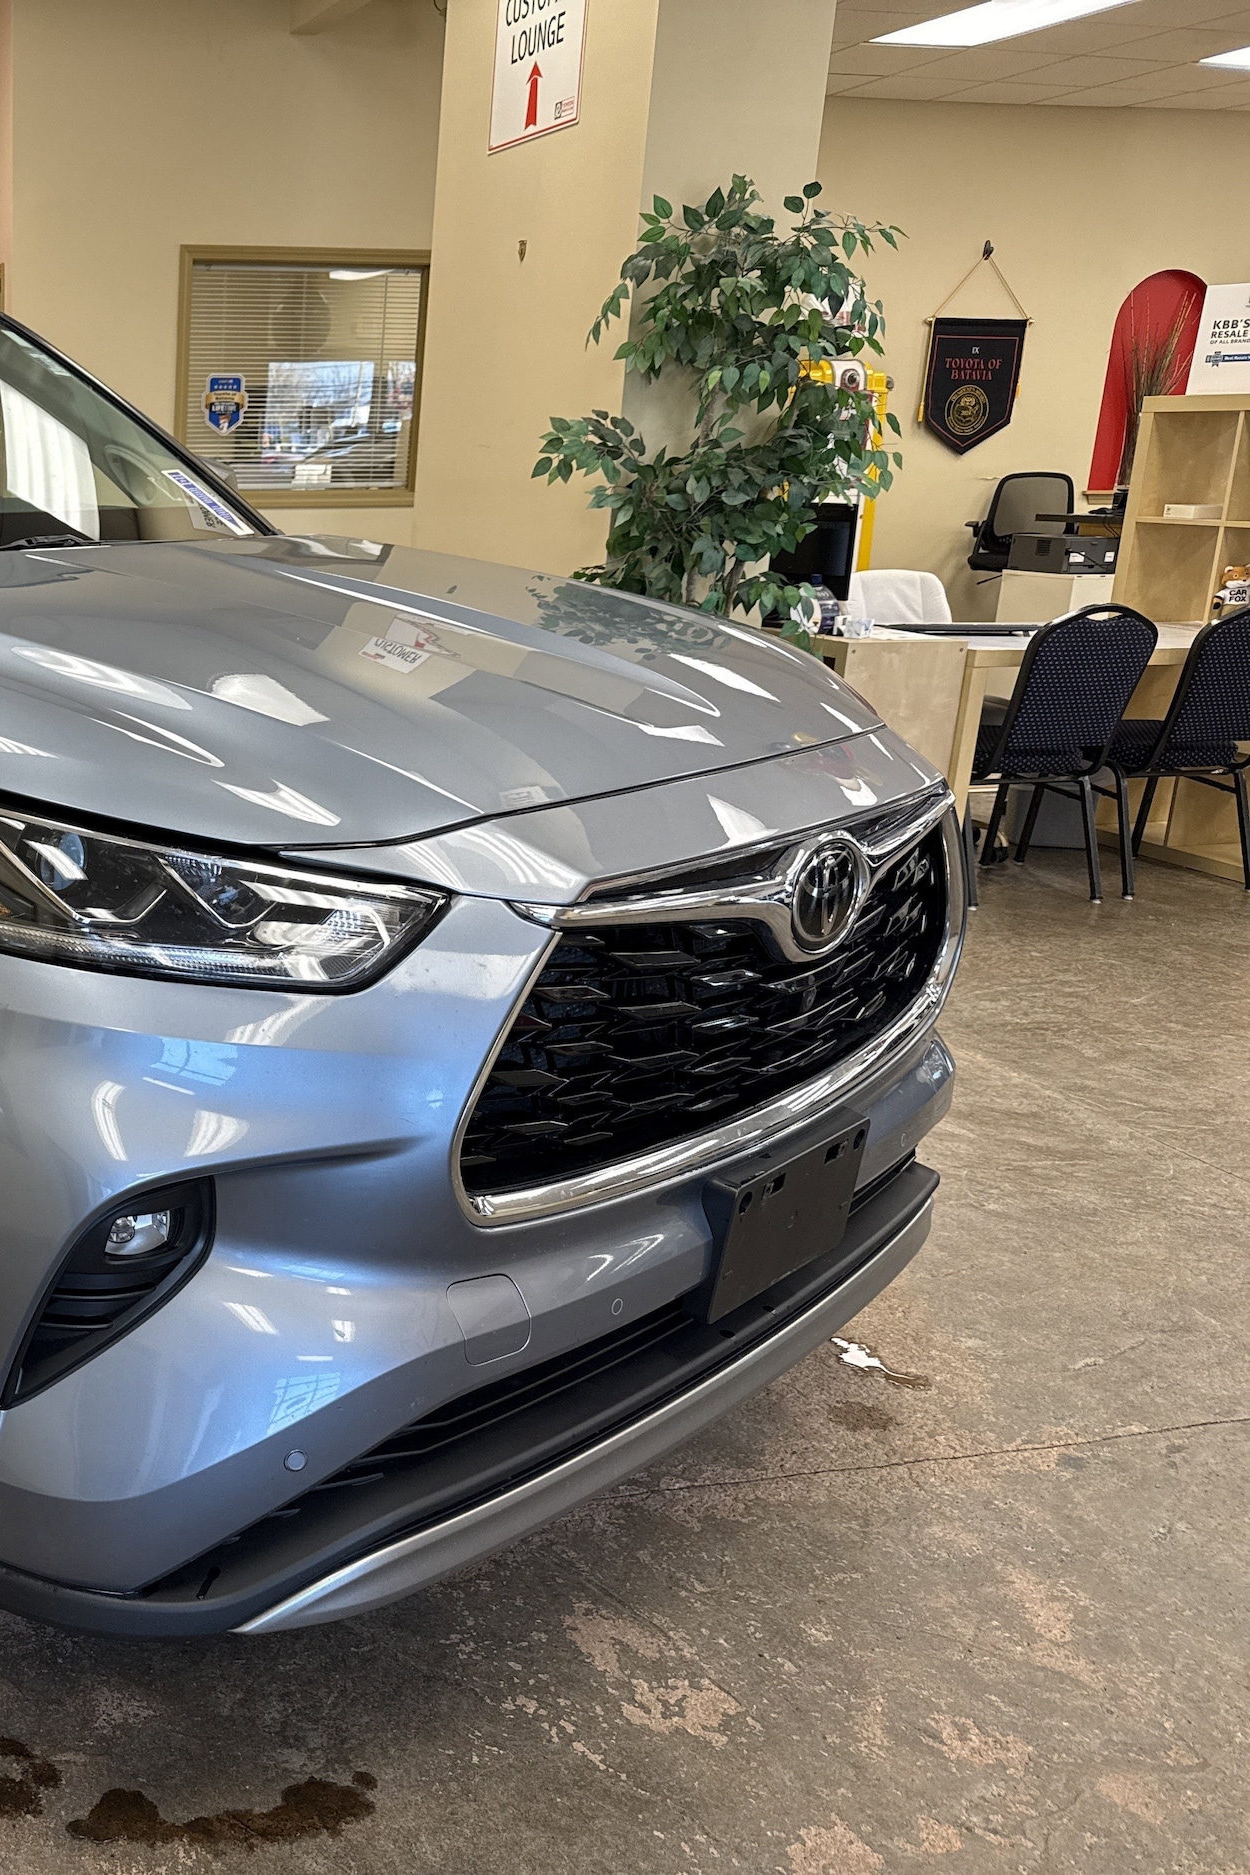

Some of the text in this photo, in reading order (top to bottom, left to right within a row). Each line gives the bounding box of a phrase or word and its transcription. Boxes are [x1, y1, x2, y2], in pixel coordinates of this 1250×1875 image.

[511, 11, 566, 65] LOUNGE
[1211, 330, 1249, 338] RESALE
[945, 358, 1003, 369] TOYOTA OF
[951, 369, 993, 380] BATAVIA
